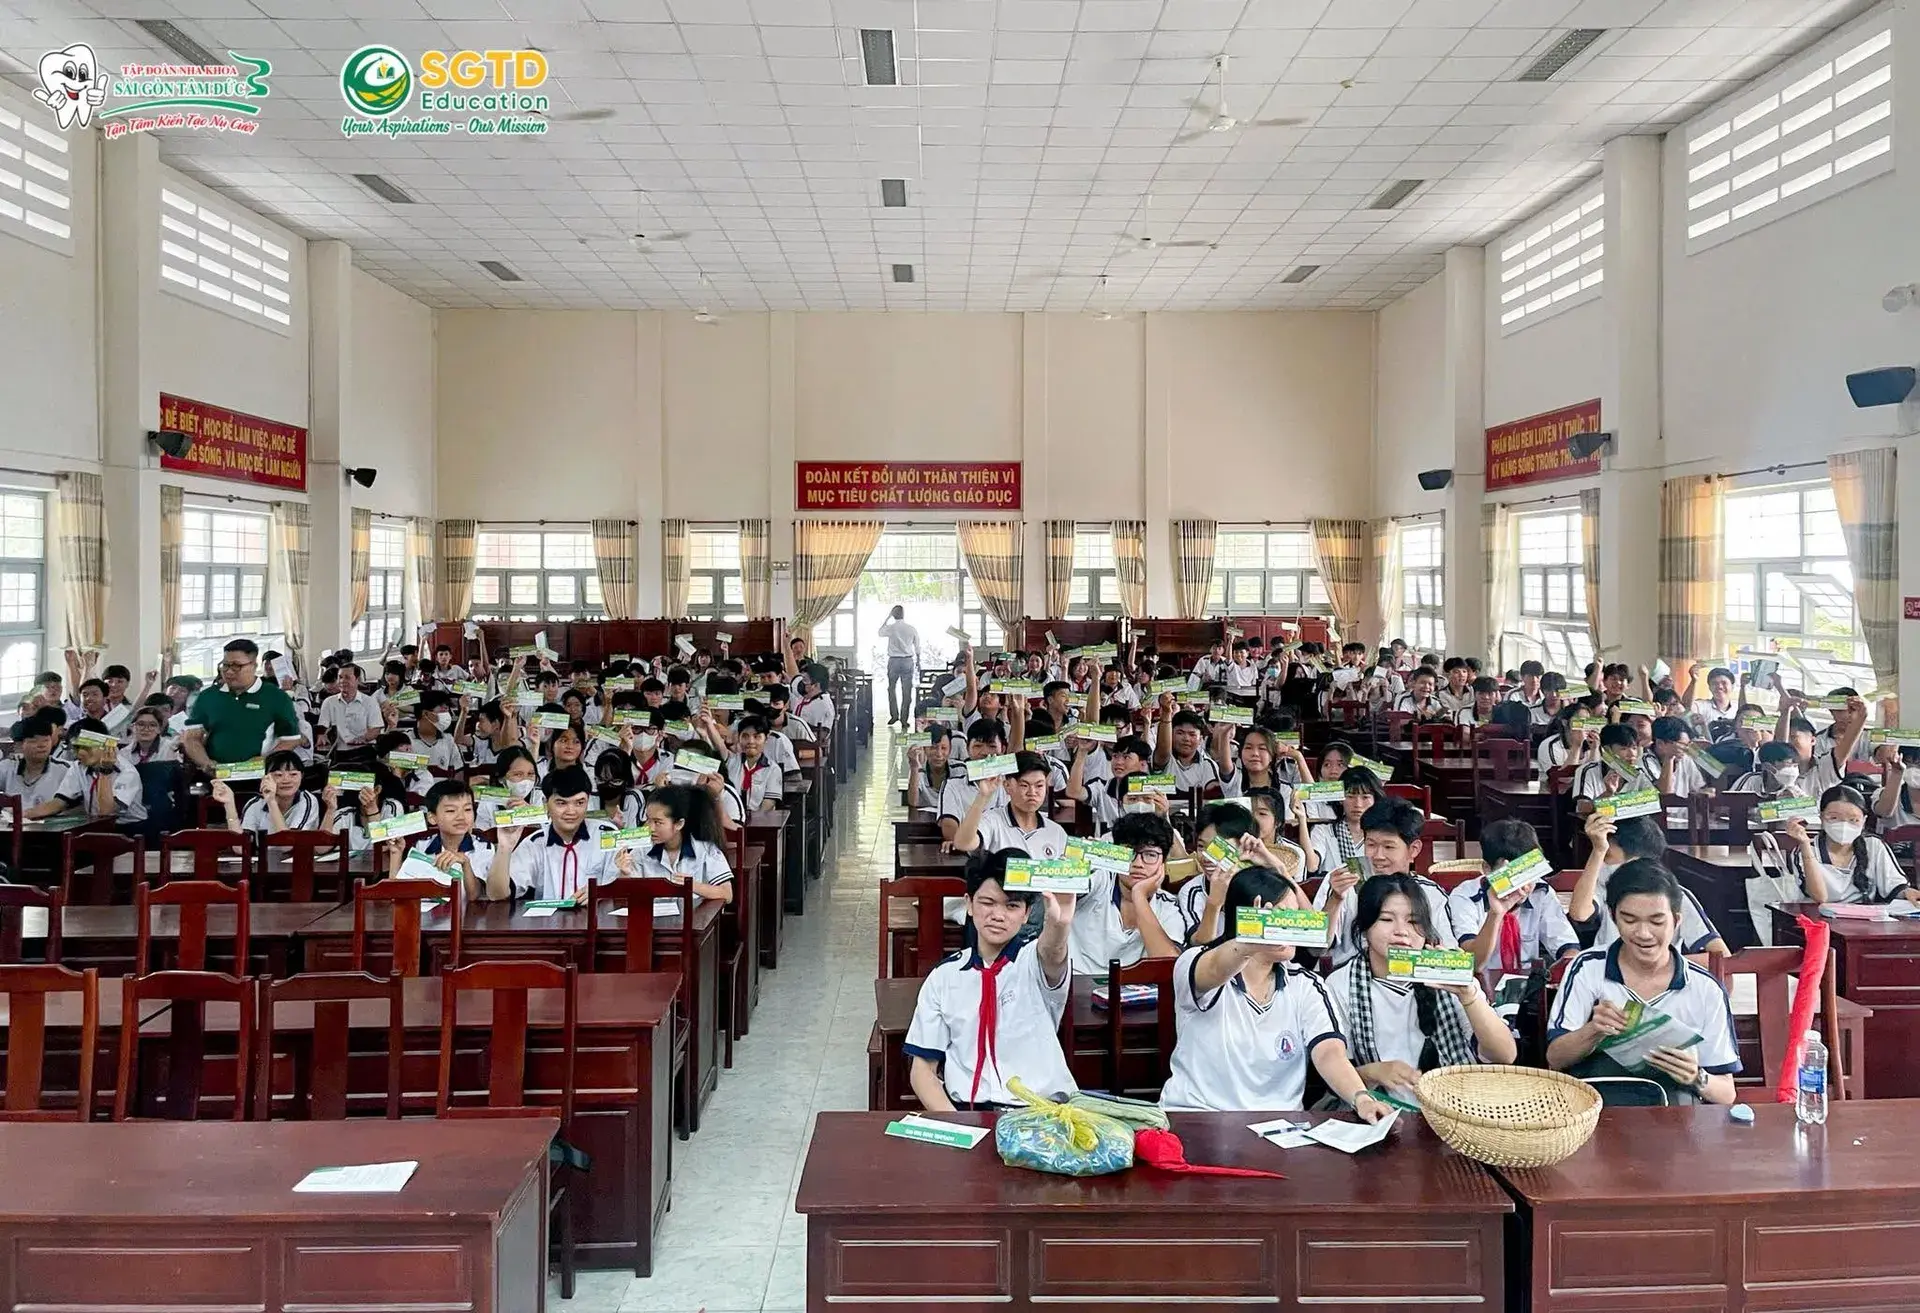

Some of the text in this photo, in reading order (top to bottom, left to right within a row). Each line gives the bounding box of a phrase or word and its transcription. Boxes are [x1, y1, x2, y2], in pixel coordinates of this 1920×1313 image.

[805, 464, 1015, 487] ĐOÀN KẾT ĐỔI MỚI THÂN THIỆN VÌ
[807, 485, 1013, 507] MỤC TIÊU CHẤT LƯỢNG GIÁO DỤC
